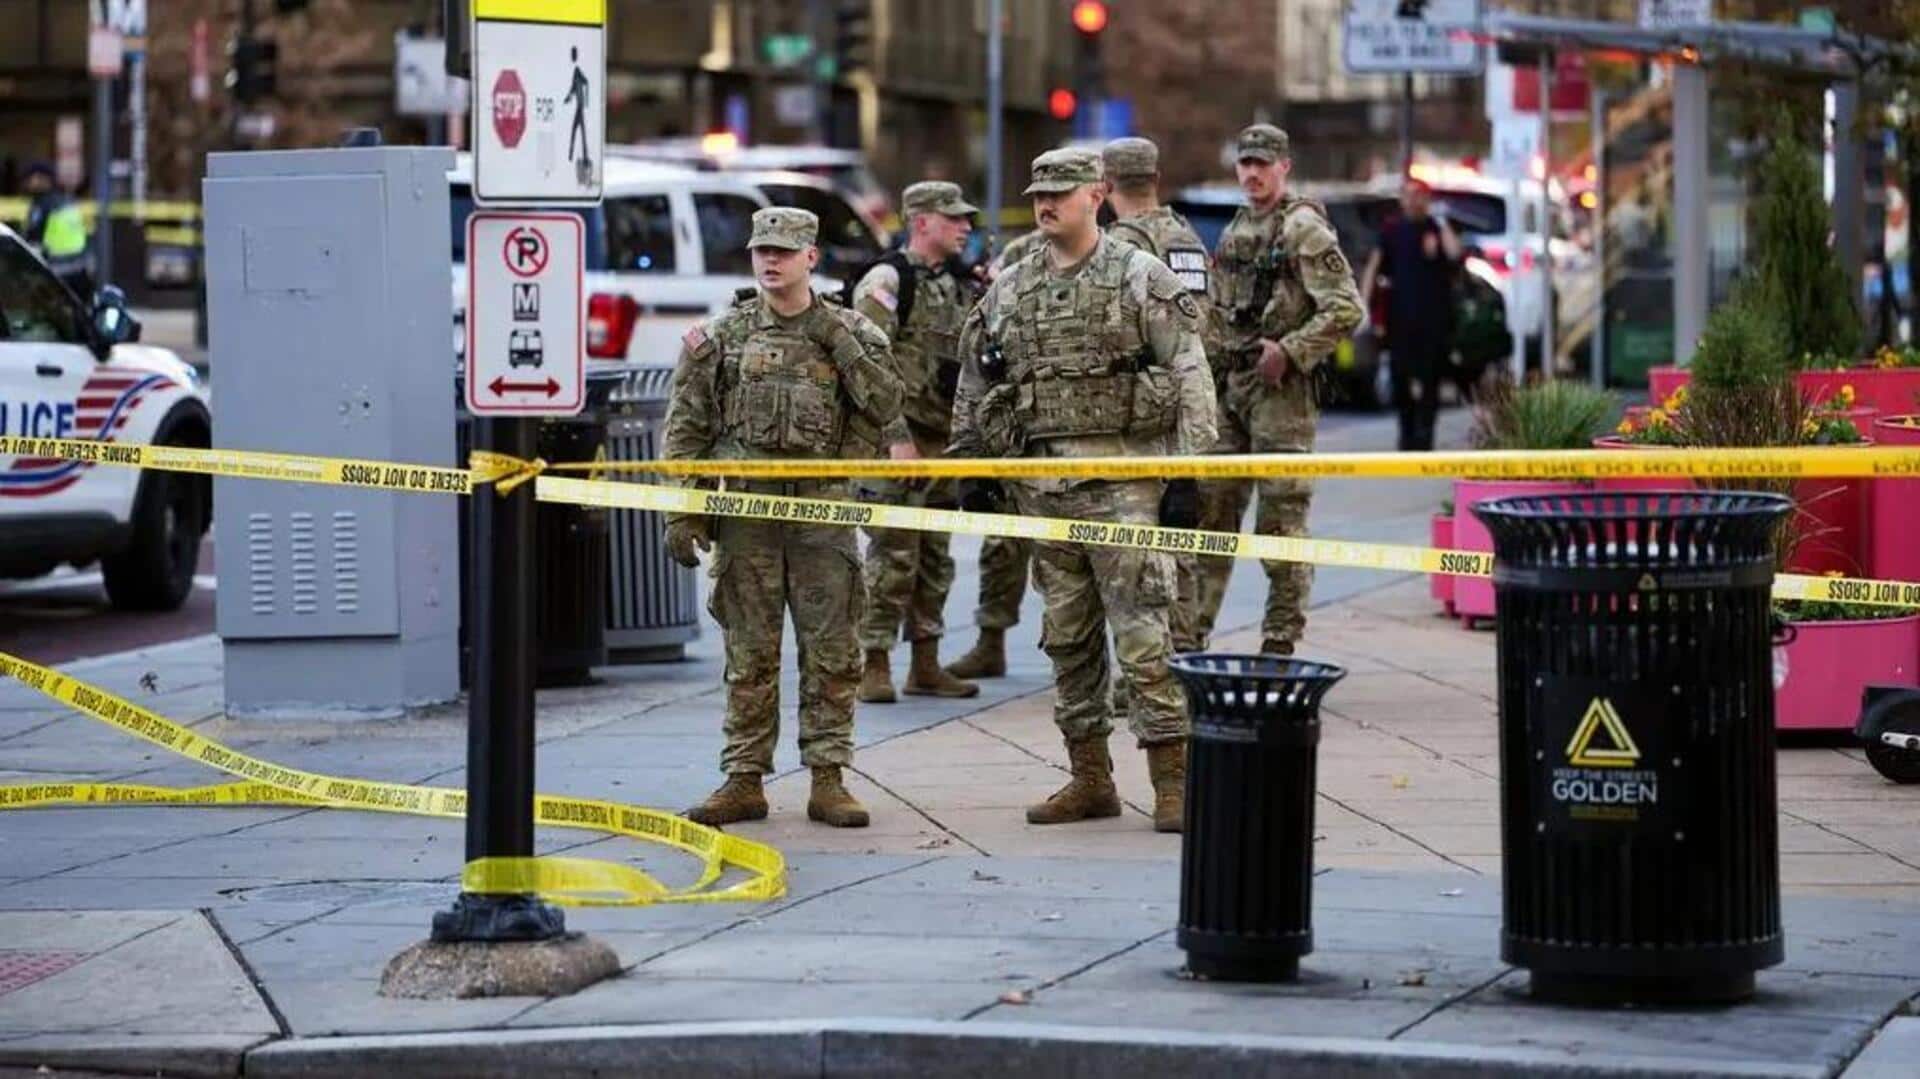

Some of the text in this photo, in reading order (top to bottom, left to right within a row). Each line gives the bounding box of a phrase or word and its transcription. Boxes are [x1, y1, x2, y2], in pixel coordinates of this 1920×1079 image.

[495, 92, 523, 119] STOP
[536, 96, 554, 122] FOR
[12, 439, 35, 456] NOT
[39, 441, 56, 458] DO
[60, 443, 98, 460] SCENE
[102, 446, 141, 464] CRIME
[341, 464, 381, 484] CROSS
[384, 467, 408, 487] NOT
[410, 470, 426, 488] DO
[430, 472, 469, 491] SCENE
[705, 495, 744, 514] CROSS
[747, 498, 768, 515] NOT
[772, 500, 789, 517] DO
[791, 503, 829, 520] SCENE
[833, 504, 873, 524] CRIME
[1068, 523, 1108, 541] CROSS
[1110, 525, 1134, 544] NOT
[1137, 528, 1154, 545] DO
[1157, 530, 1196, 549] SCENE
[1199, 533, 1239, 553] CRIME
[1440, 552, 1481, 573] CROSS
[1828, 580, 1871, 601] CROSS
[1873, 582, 1900, 602] NOT
[72, 685, 103, 712] CROSS
[45, 785, 74, 799] CROSS
[1552, 778, 1657, 804] GOLDEN
